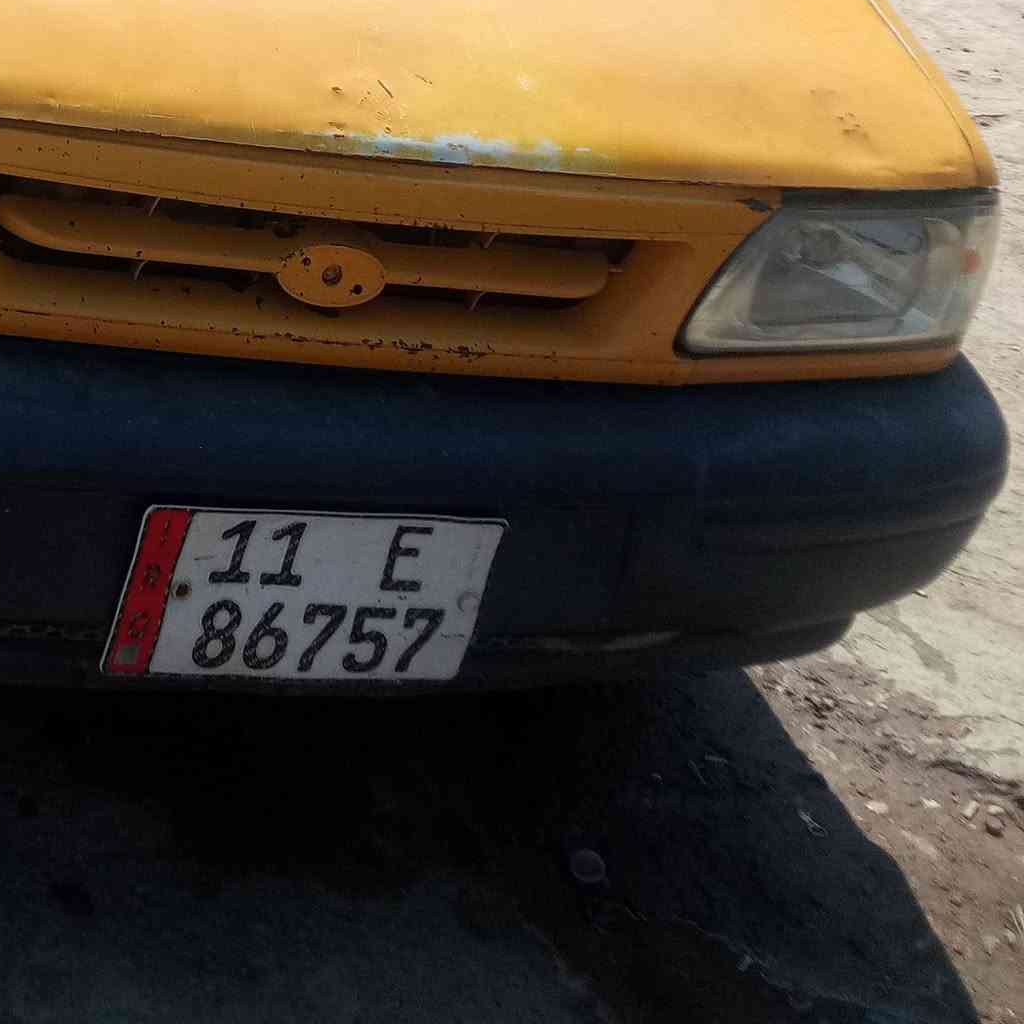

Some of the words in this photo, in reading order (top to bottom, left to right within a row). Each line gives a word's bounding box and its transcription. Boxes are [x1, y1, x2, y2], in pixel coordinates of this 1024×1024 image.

[208, 519, 307, 587] 11
[380, 525, 434, 592] E
[191, 599, 446, 673] 86757
